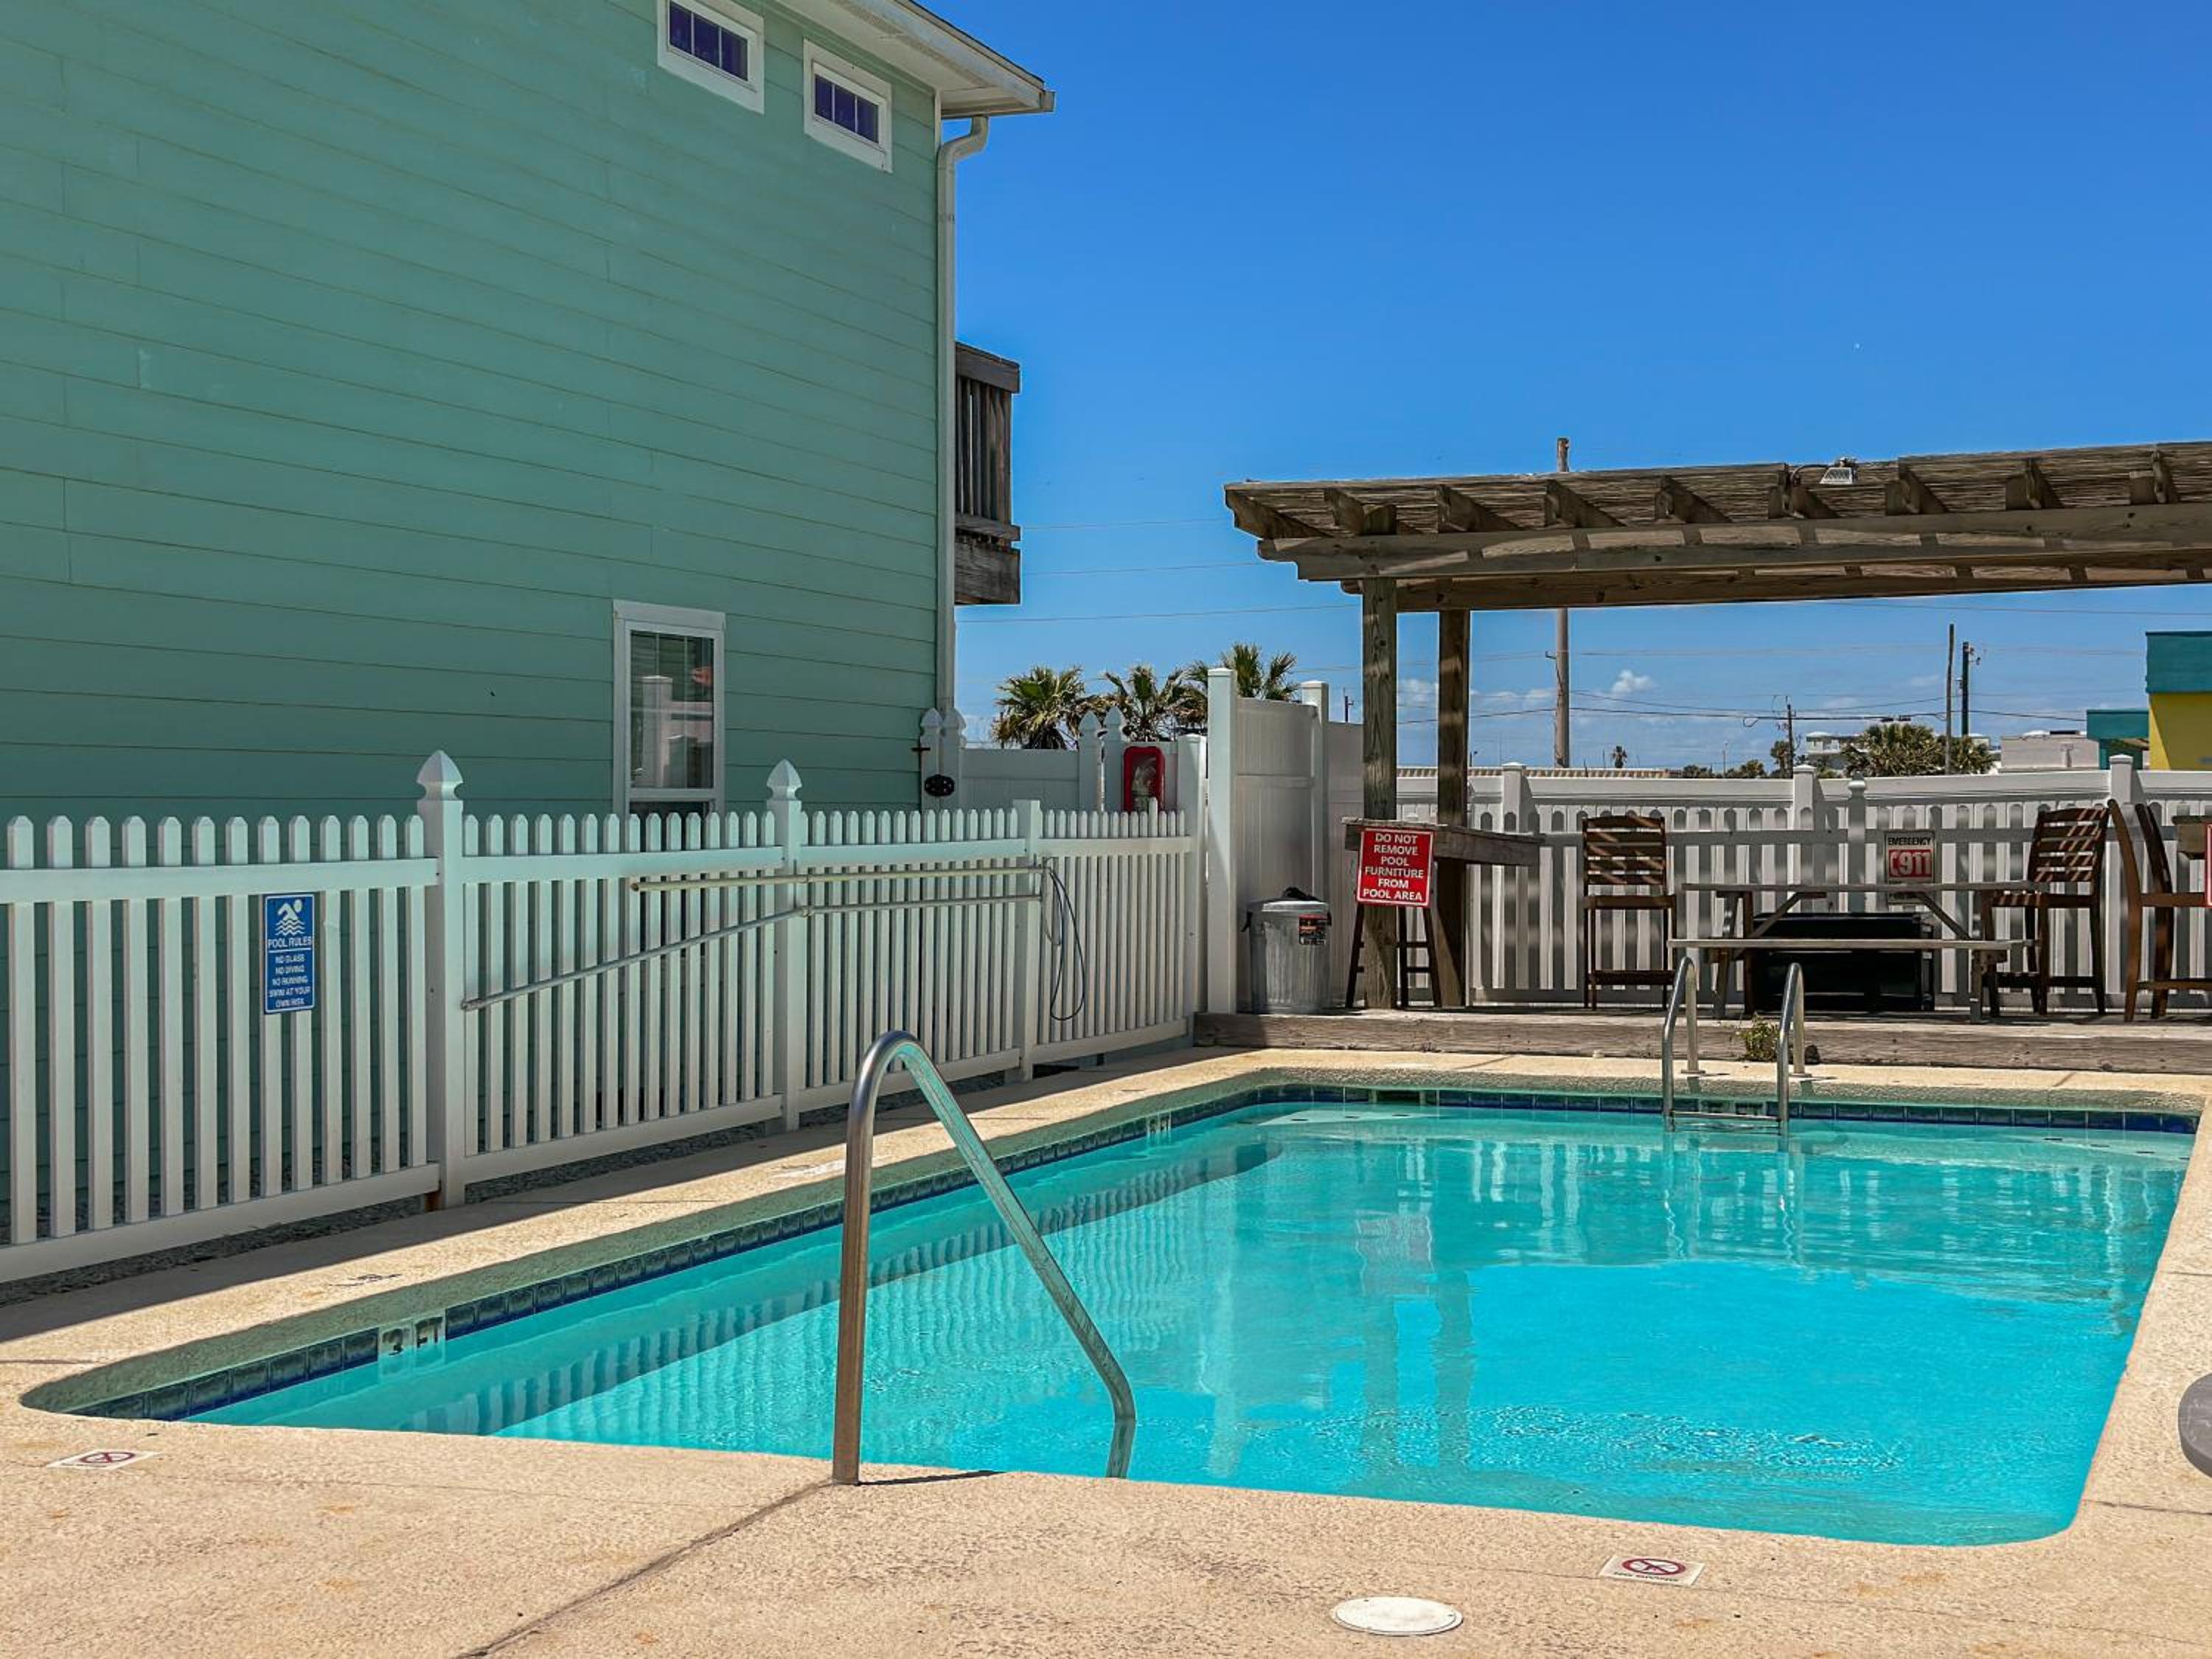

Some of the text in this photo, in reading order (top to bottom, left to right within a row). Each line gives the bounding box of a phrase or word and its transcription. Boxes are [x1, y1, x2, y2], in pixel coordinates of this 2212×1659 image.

[1375, 833, 1418, 844] DO NOT
[1374, 844, 1419, 855] REMOVE
[1381, 856, 1410, 866] POOL
[1899, 852, 1932, 874] 911
[1365, 866, 1424, 878] FURNITURE
[1378, 878, 1409, 888] FROM
[1363, 888, 1422, 902] POOL AREA
[268, 936, 312, 948] POOL RULES
